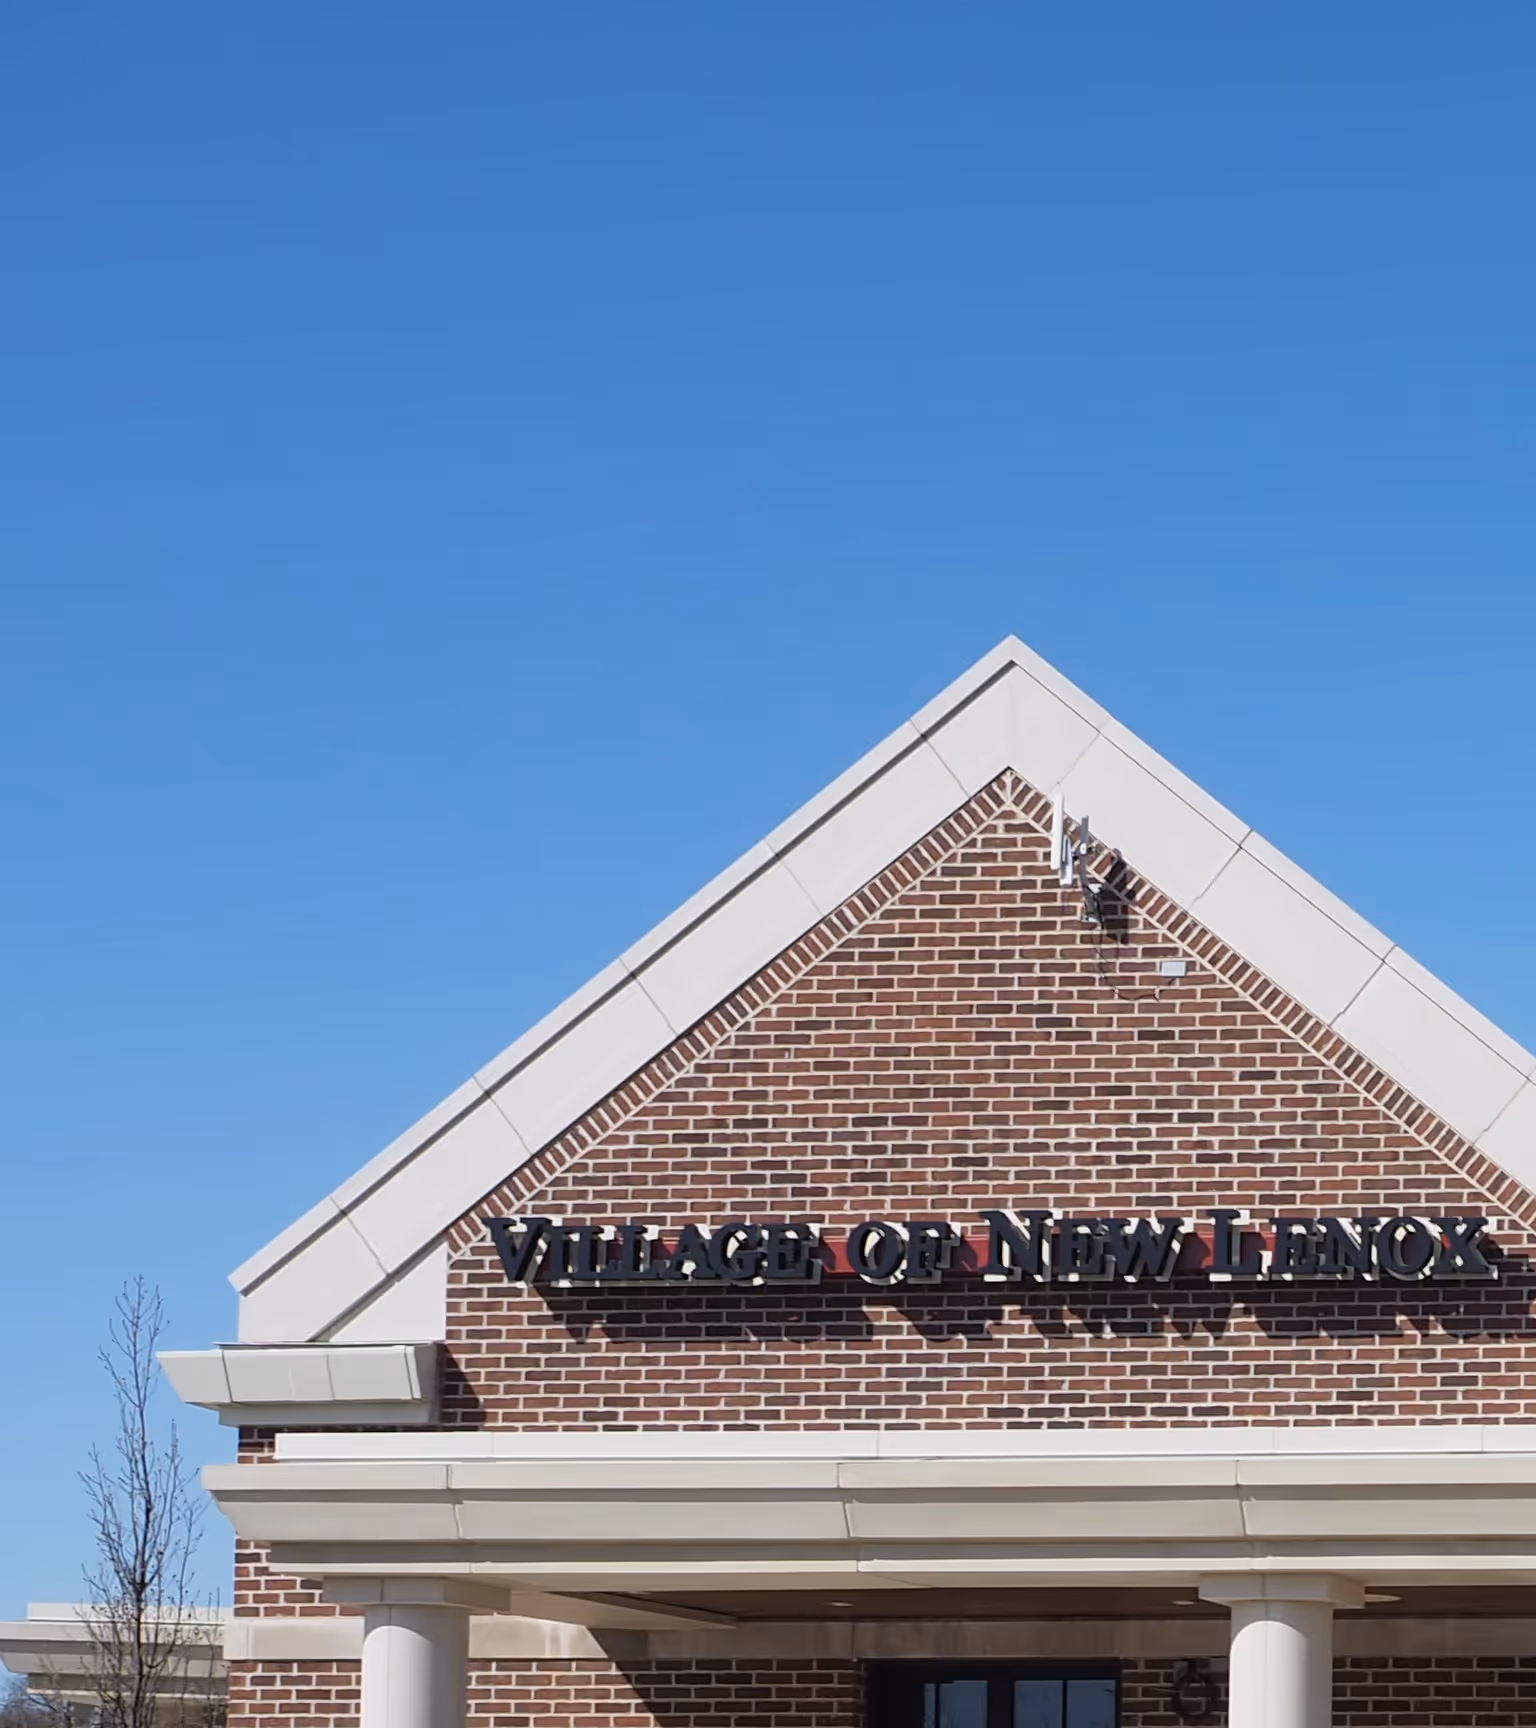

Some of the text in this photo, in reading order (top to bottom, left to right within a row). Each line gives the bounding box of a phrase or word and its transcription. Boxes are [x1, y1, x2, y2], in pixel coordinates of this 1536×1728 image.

[483, 1208, 1492, 1284] VILLAGE OF NEW LENOX
